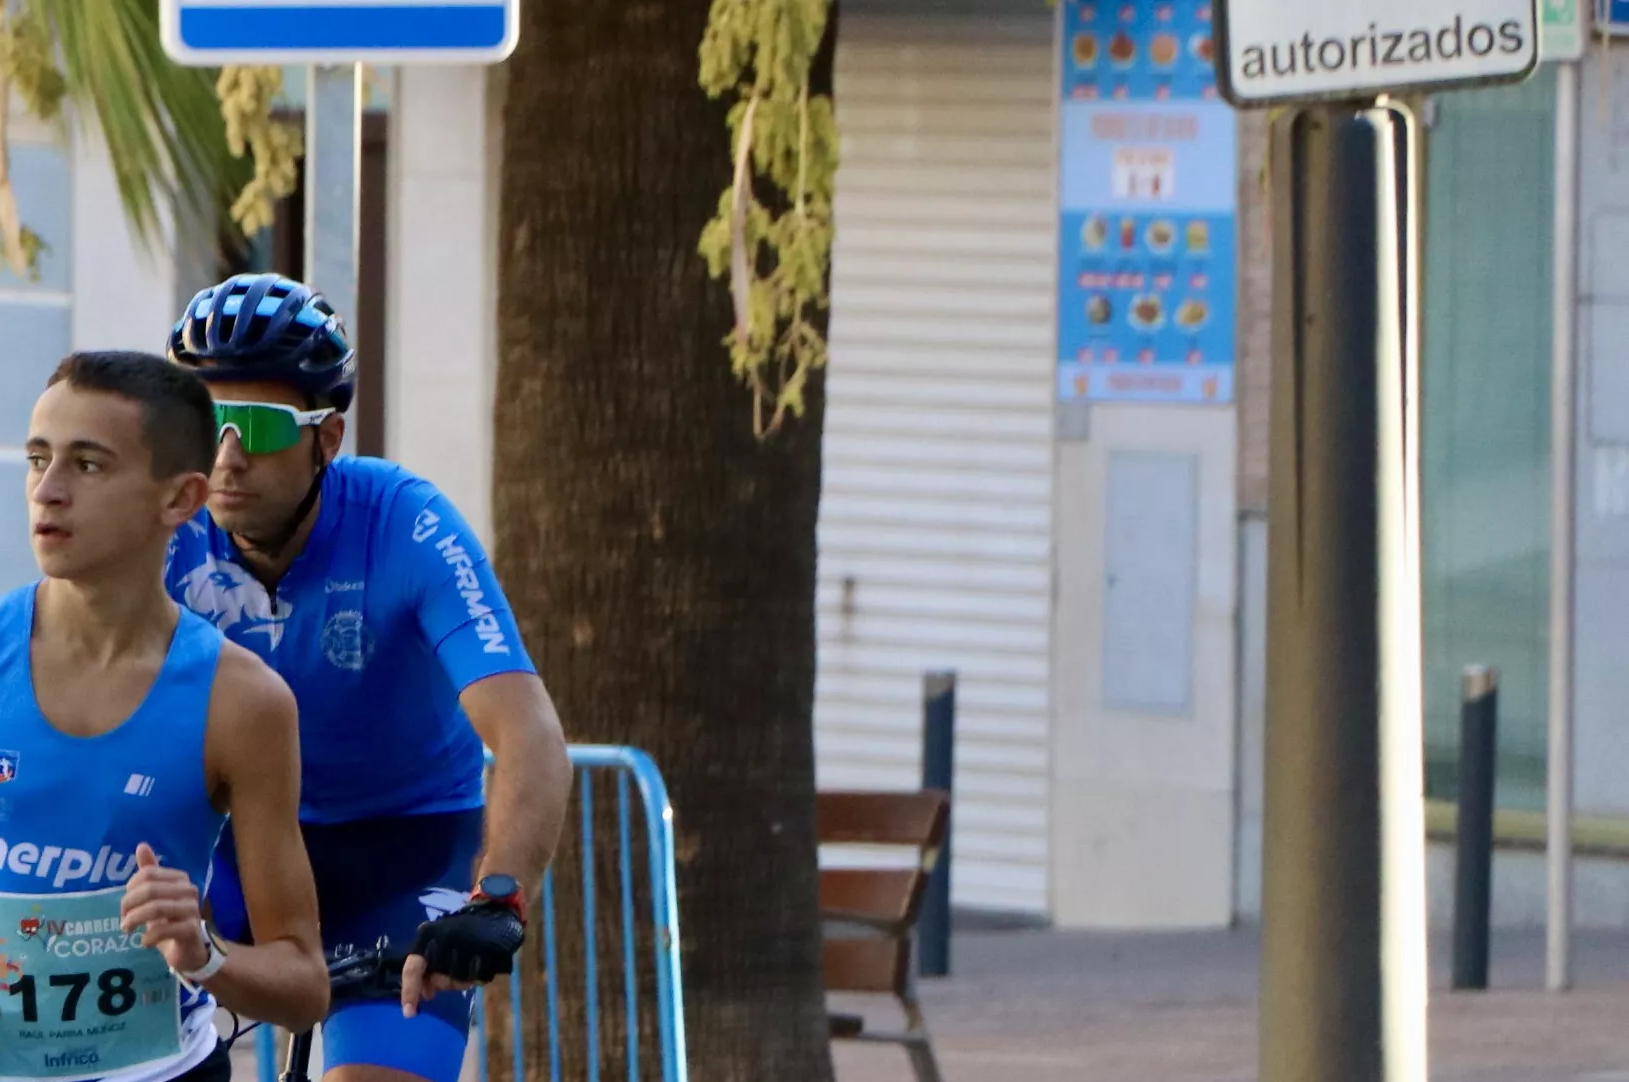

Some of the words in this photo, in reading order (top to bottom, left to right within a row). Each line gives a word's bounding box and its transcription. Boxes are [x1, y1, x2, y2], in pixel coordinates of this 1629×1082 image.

[1241, 15, 1525, 80] autorizados
[65, 917, 123, 937] CARRER
[55, 931, 145, 958] CORAZO
[9, 968, 136, 1022] 178
[44, 1052, 100, 1068] Infrico
